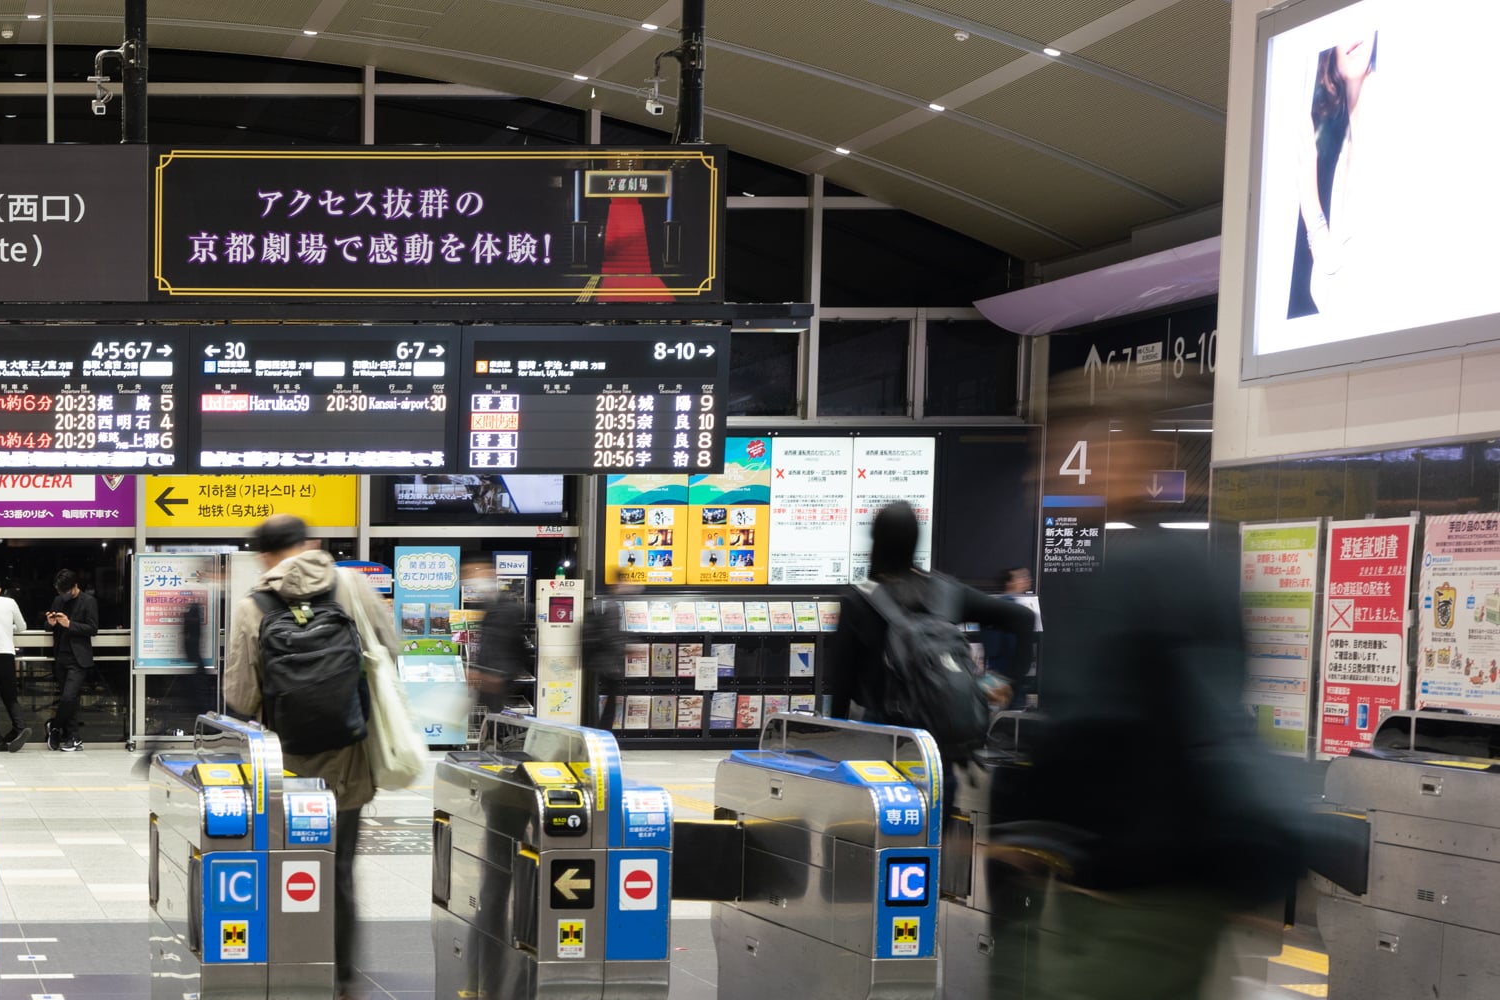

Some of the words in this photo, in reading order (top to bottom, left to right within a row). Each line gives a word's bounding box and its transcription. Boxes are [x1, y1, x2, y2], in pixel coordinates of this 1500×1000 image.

[606, 176, 648, 192] 京都劇場
[258, 188, 484, 219] アクセス抜群の
[225, 342, 245, 359] 30
[654, 342, 695, 359] 8-10
[55, 395, 95, 411] 20:23
[161, 395, 173, 411] 5
[327, 396, 367, 411] 20:30
[368, 396, 429, 411] Kansai-airport
[430, 395, 446, 411] 30
[596, 396, 636, 411] 20:24
[701, 395, 713, 411] 9
[55, 415, 95, 430] 20:28
[160, 415, 173, 430] 4
[596, 415, 635, 430] 20:35
[699, 415, 714, 430] 10
[55, 433, 95, 448] 20:29
[160, 433, 172, 448] 6
[594, 433, 633, 448] 20:41
[698, 433, 711, 448] 8
[593, 452, 634, 467] 20:56
[697, 452, 711, 467] 8
[1059, 441, 1091, 484] 4
[198, 484, 295, 498] 지하철(가라스마
[299, 484, 316, 498] 선)
[1045, 538, 1073, 546] 三ノ宮
[1340, 535, 1399, 558] 遅延証明書
[403, 572, 452, 581] おでかけ情報
[424, 723, 443, 734] JR
[884, 786, 912, 803] IC
[885, 809, 920, 826] 専用
[217, 871, 253, 902] IC
[891, 866, 925, 898] IC
